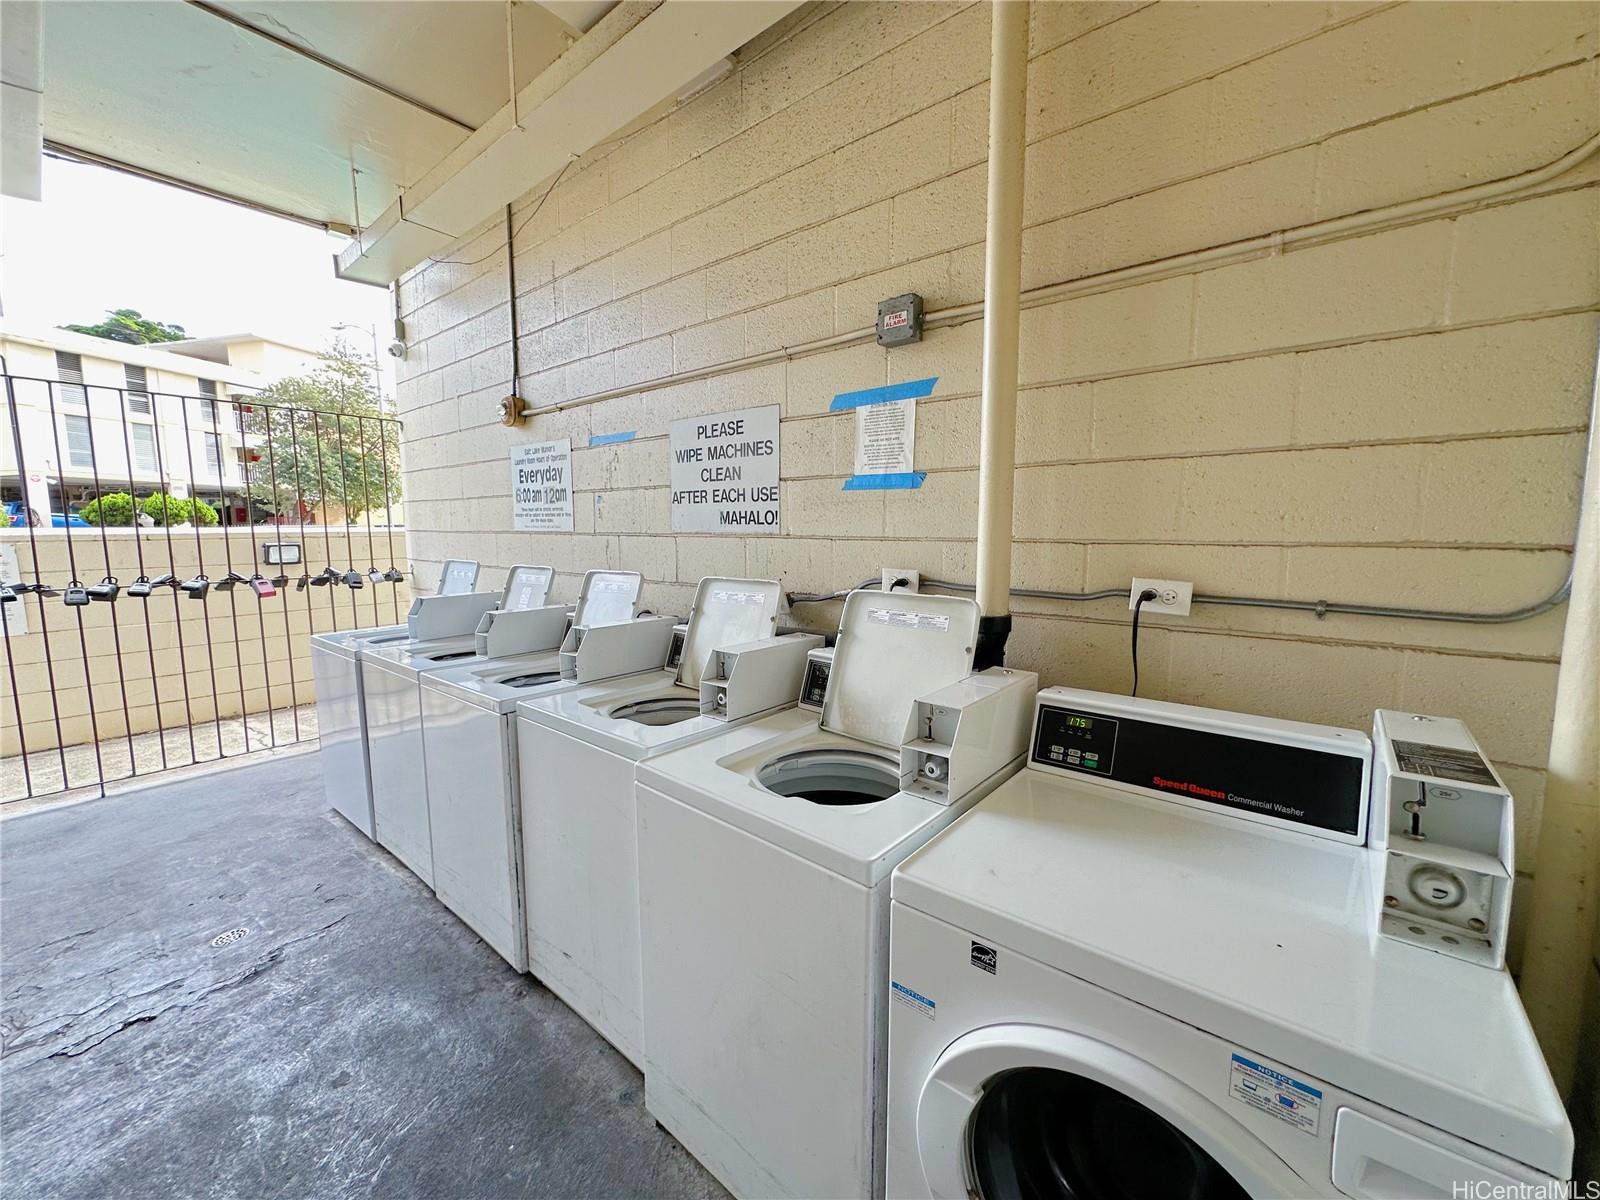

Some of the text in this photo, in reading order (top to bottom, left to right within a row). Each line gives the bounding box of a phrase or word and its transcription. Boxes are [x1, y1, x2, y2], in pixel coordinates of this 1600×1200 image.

[885, 318, 907, 328] ALARM
[888, 313, 903, 321] FIRE
[697, 419, 744, 440] PLEASE
[675, 439, 774, 464] WIPE MACHINES
[518, 465, 564, 485] Everyday
[700, 465, 742, 483] CLEAN
[672, 486, 779, 505] AFTER EACH USE
[719, 509, 778, 526] MAHALO!
[1152, 776, 1305, 817] Speed Queen Commercial Washer
[897, 984, 929, 1004] NOTICE
[1257, 1065, 1294, 1086] NOTICE
